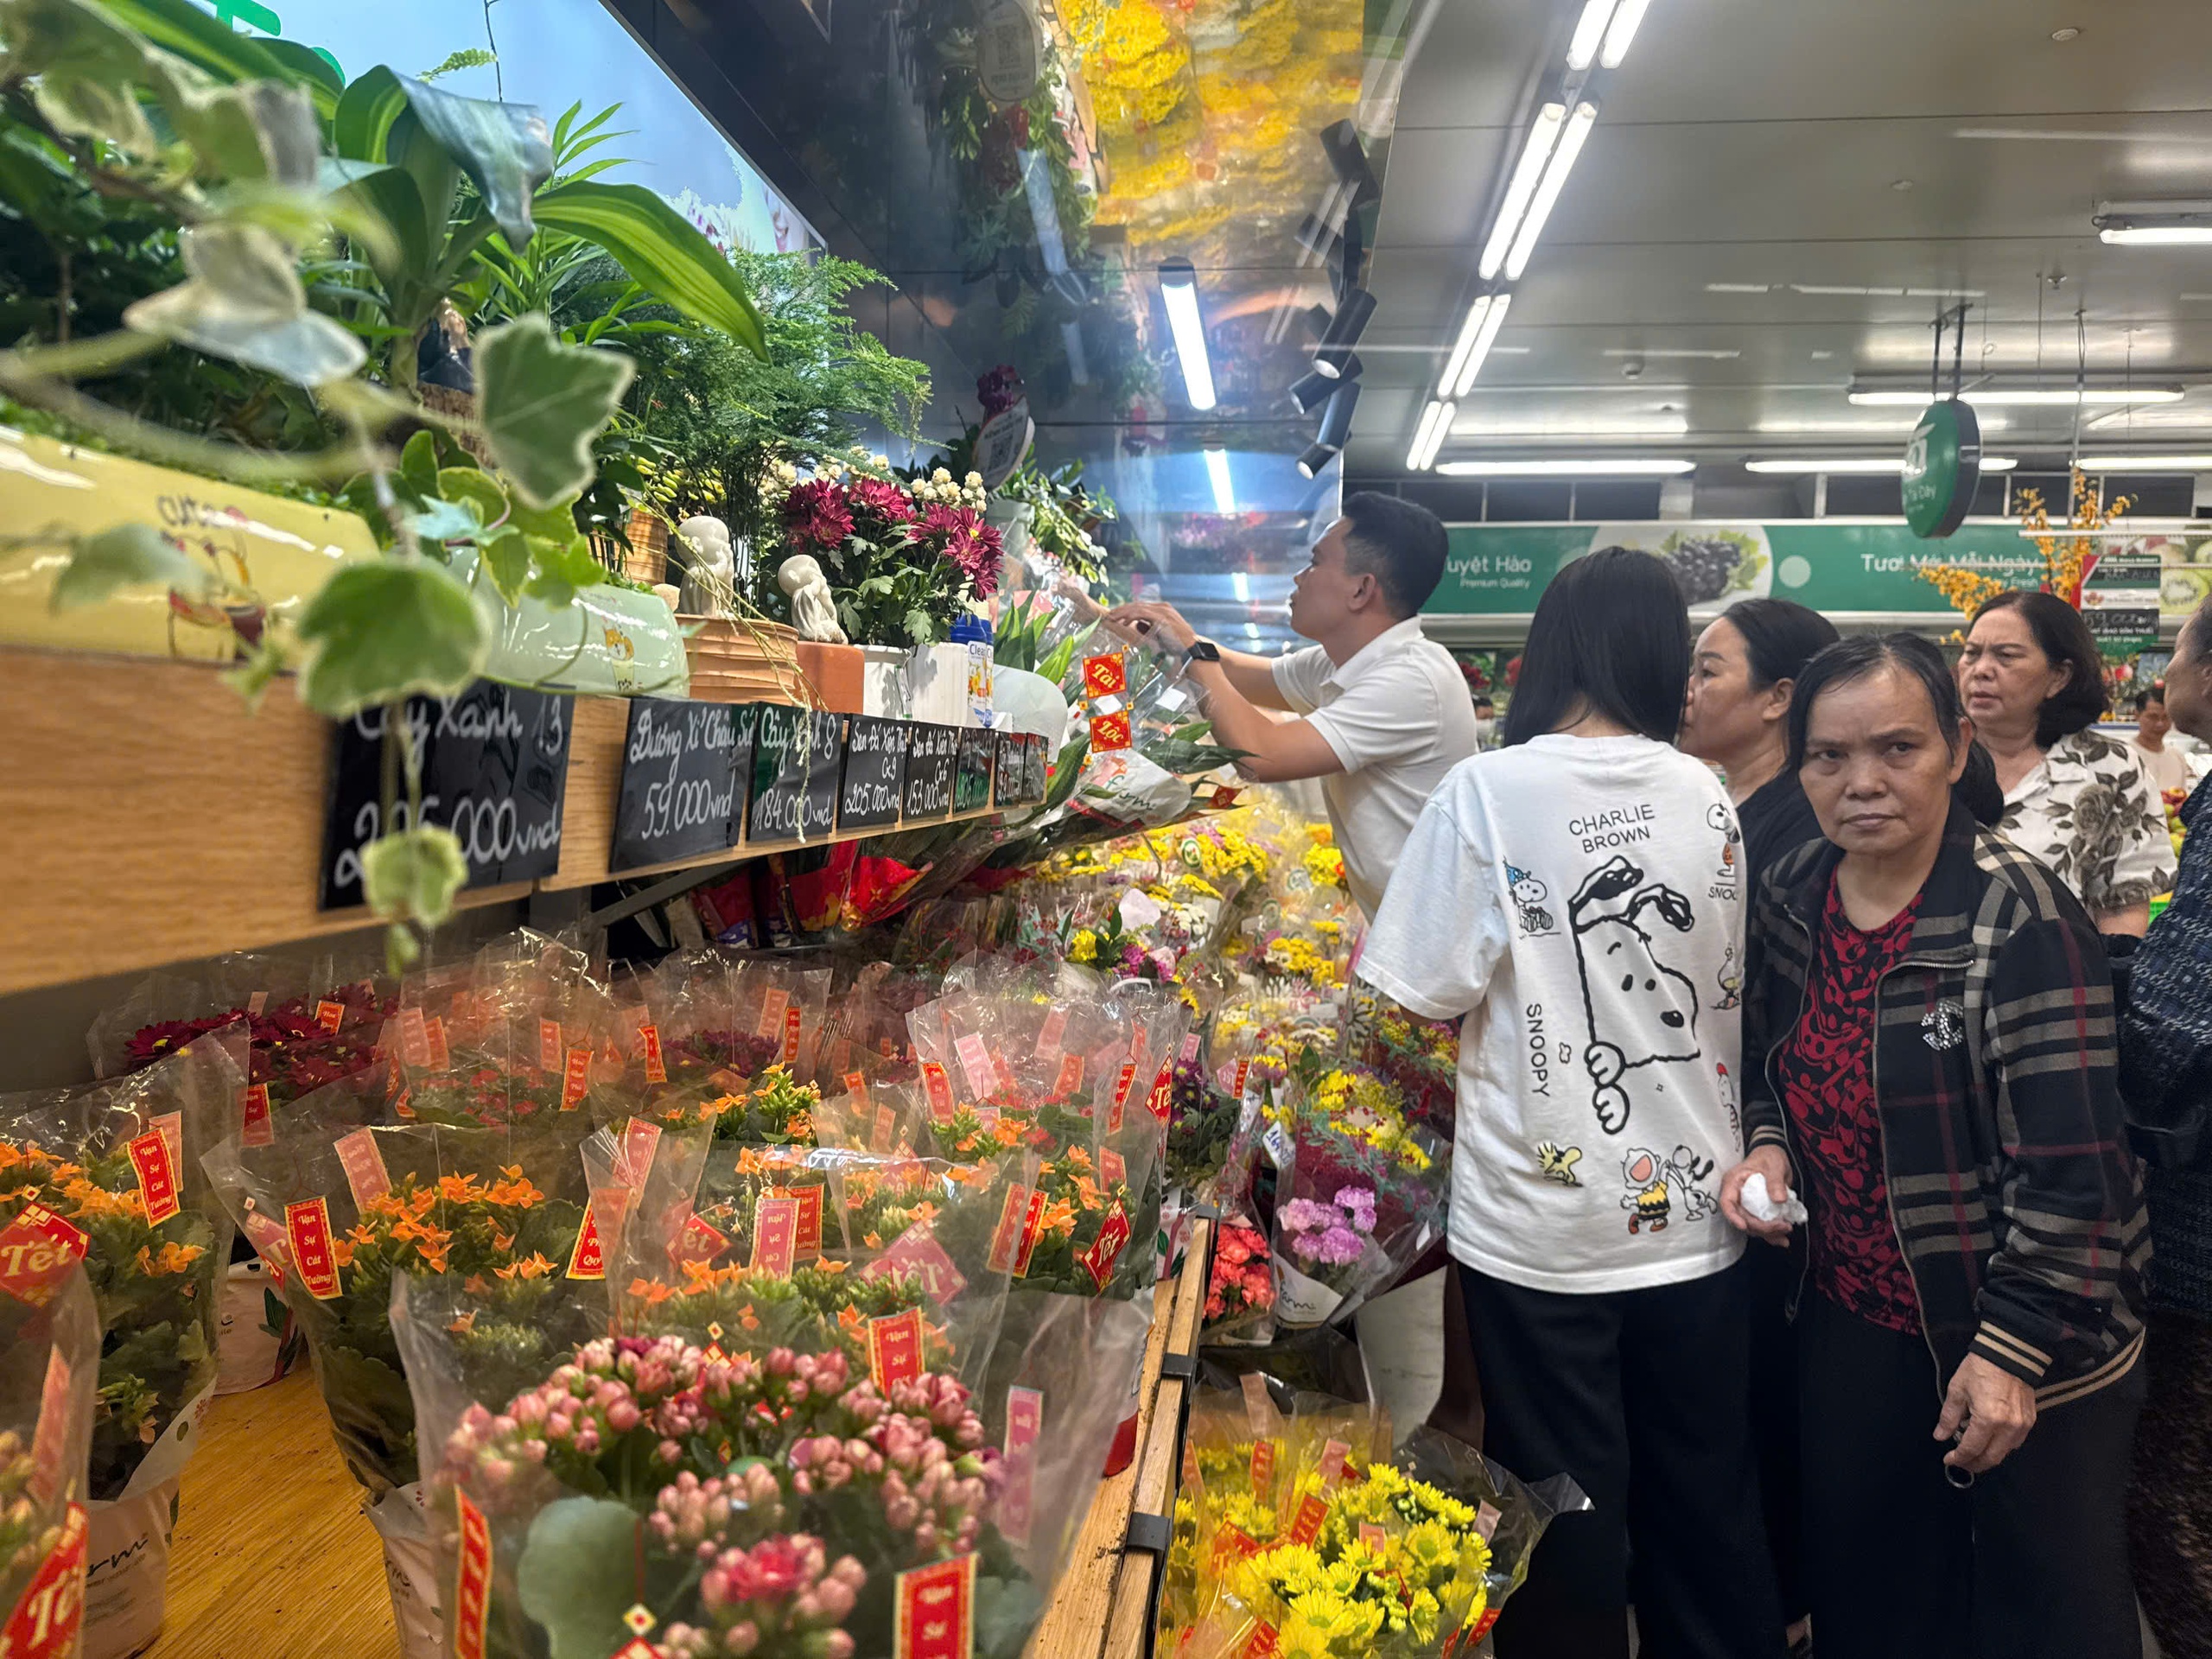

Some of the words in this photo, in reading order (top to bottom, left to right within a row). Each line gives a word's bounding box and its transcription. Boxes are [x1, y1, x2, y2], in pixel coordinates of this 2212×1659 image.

[1446, 556, 1489, 576] uyệt
[1460, 579, 1497, 588] Premium
[1499, 578, 1531, 589] Quality
[1094, 664, 1120, 689] Tài
[435, 689, 523, 739] Xanh
[704, 709, 736, 754] Chậu
[761, 706, 790, 777] Cây
[825, 714, 836, 760] 8
[852, 722, 867, 753] Sen
[868, 723, 882, 752] Đá
[912, 728, 925, 758] Sen
[1097, 720, 1124, 743] Lộc
[641, 768, 735, 840] 59.000vnd
[845, 782, 901, 817] 205.000vnd
[1569, 804, 1655, 836] CHARLIE
[1582, 826, 1650, 854] BROWN
[1526, 1003, 1550, 1096] SNOOPY
[1154, 1083, 1171, 1110] Tế
[140, 1145, 157, 1157] Vạn
[149, 1164, 160, 1175] Sự
[151, 1180, 164, 1192] Cát
[297, 1214, 317, 1225] Vạn
[304, 1234, 316, 1247] Sự
[588, 1237, 602, 1248] Ph
[682, 1224, 711, 1254] ết
[1097, 1227, 1120, 1268] Tết
[1, 1233, 72, 1277] Tết
[306, 1255, 321, 1267] Cát
